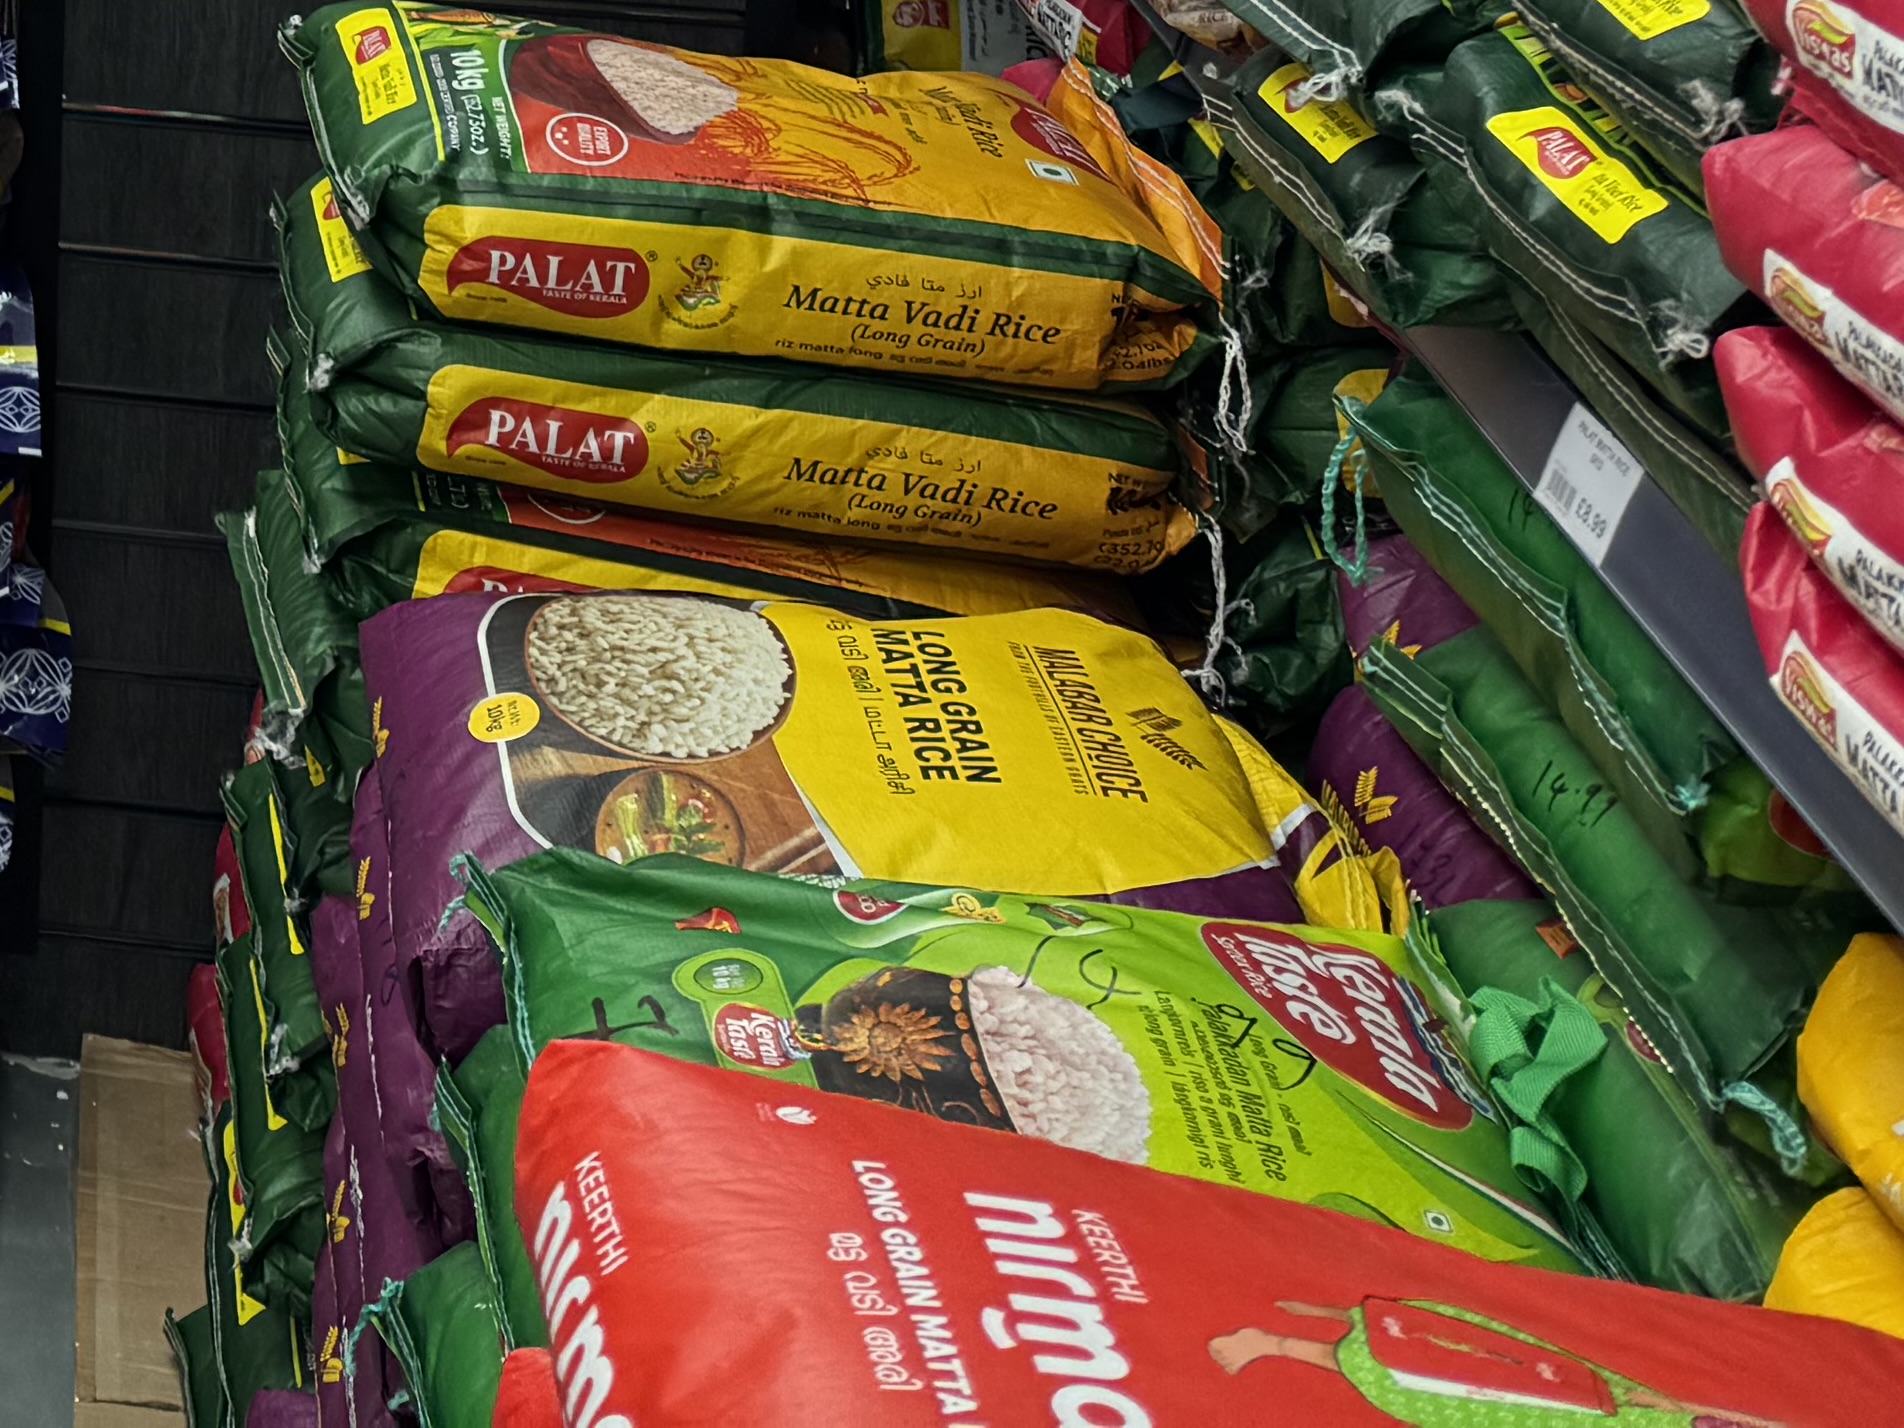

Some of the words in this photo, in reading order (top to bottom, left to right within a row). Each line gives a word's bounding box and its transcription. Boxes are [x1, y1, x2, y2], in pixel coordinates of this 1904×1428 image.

[449, 48, 489, 91] 10kg
[1537, 128, 1591, 176] PALAT
[485, 249, 638, 297] PALAT
[542, 288, 572, 299] TASTE
[589, 292, 628, 304] KERALA
[782, 282, 889, 323] Matta
[904, 298, 977, 335] Vadi
[990, 314, 1063, 347] Rice
[850, 322, 910, 347] (Long
[918, 329, 987, 358] Grain)
[800, 341, 846, 356] matta
[849, 346, 884, 362] long
[485, 408, 634, 465] PALAT
[782, 456, 891, 495] Matta
[903, 472, 978, 509] Vadi
[989, 489, 1059, 522] Rice
[847, 490, 909, 516] (Long
[913, 498, 983, 528] Grain)
[1574, 497, 1608, 540] £8.99
[870, 626, 926, 709] MATTA
[903, 711, 960, 783] RICE
[910, 629, 953, 692] LONG
[942, 695, 1003, 786] GRAIN
[1034, 644, 1092, 729] MALABAR
[1078, 732, 1149, 804] CHOICE
[1241, 932, 1357, 1045] Taste
[1313, 952, 1440, 1115] Kerala
[1236, 1088, 1273, 1138] Matta
[1256, 1143, 1288, 1182] Rice
[573, 1149, 629, 1277] KEERTHI
[850, 1158, 893, 1224] LONG
[880, 1226, 942, 1309] GRAIN
[1071, 1207, 1149, 1305] KEERTHI
[909, 1311, 979, 1415] MATTA
